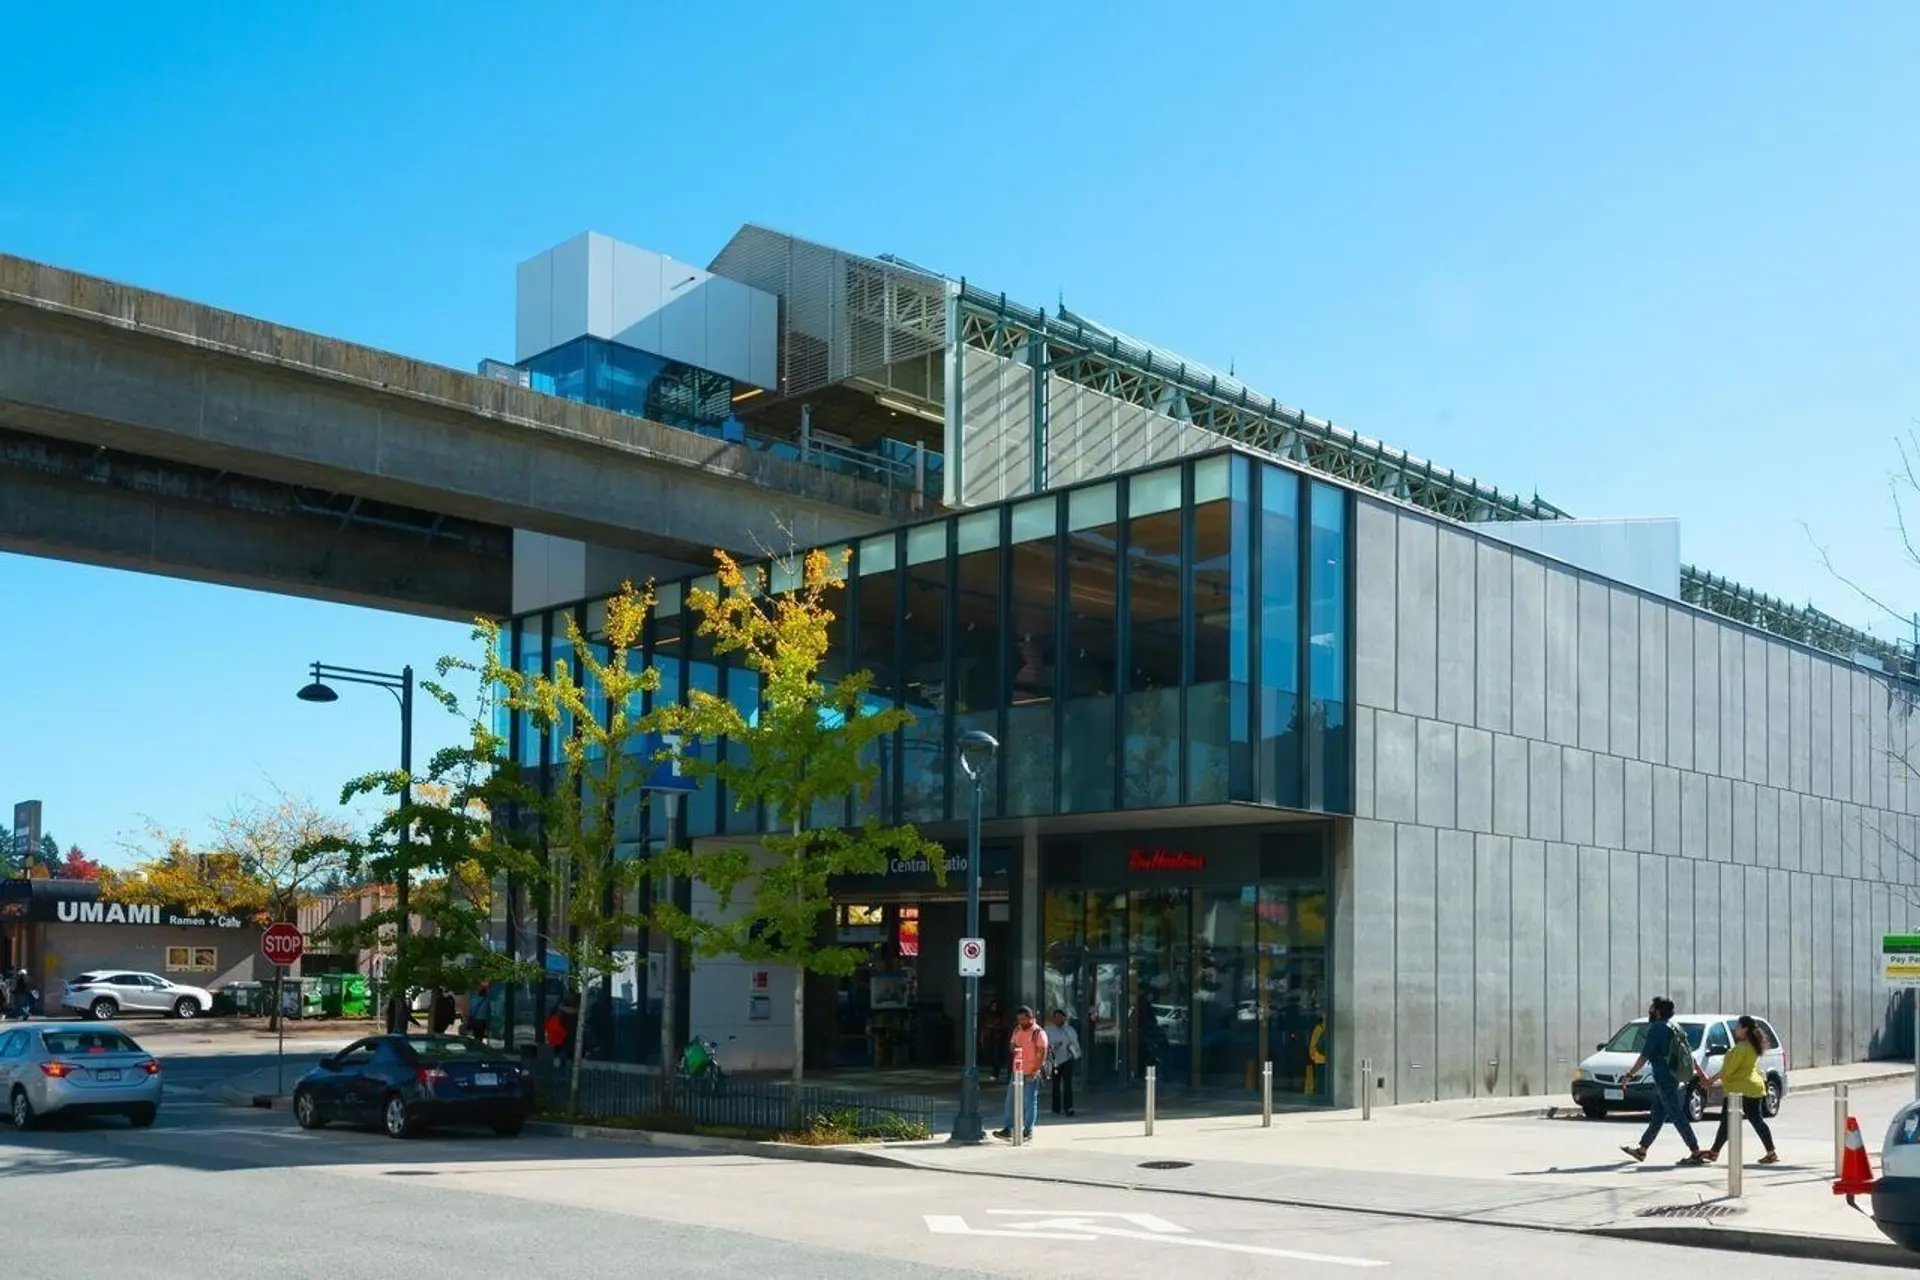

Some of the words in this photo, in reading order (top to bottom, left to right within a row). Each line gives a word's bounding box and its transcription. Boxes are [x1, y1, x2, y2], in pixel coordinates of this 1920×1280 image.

[891, 857, 930, 873] Central
[57, 901, 160, 924] UMAMI
[169, 915, 205, 926] Ramen
[265, 935, 300, 952] STOP
[1889, 955, 1906, 964] Pay
